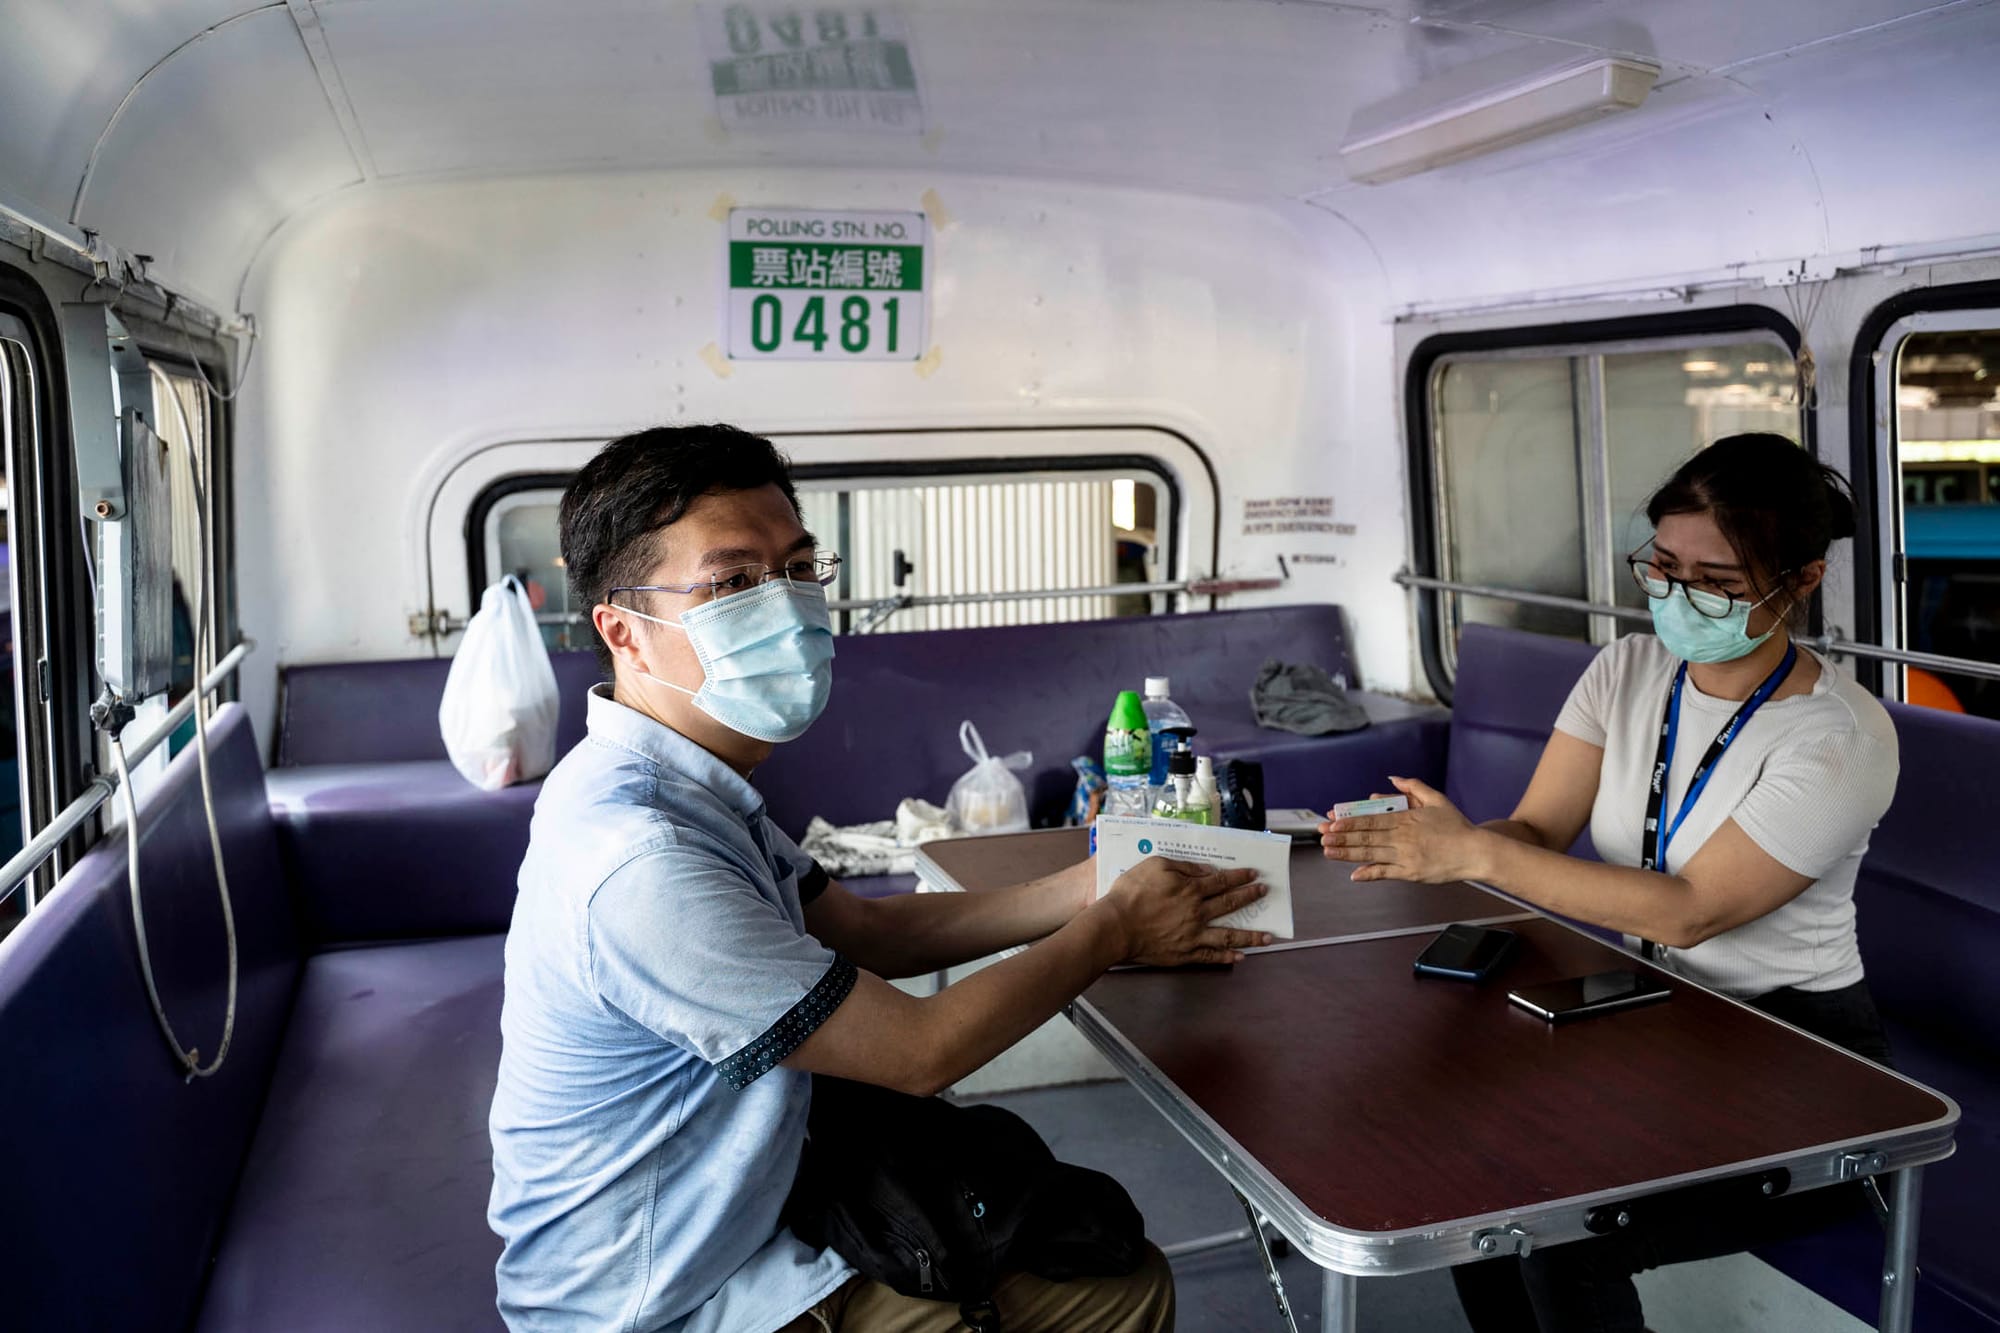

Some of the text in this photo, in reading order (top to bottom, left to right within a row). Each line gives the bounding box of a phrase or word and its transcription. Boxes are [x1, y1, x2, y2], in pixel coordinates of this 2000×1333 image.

[747, 218, 908, 240] POLLING STN. NO.
[752, 247, 903, 288] 票站編號
[751, 293, 900, 353] 0481
